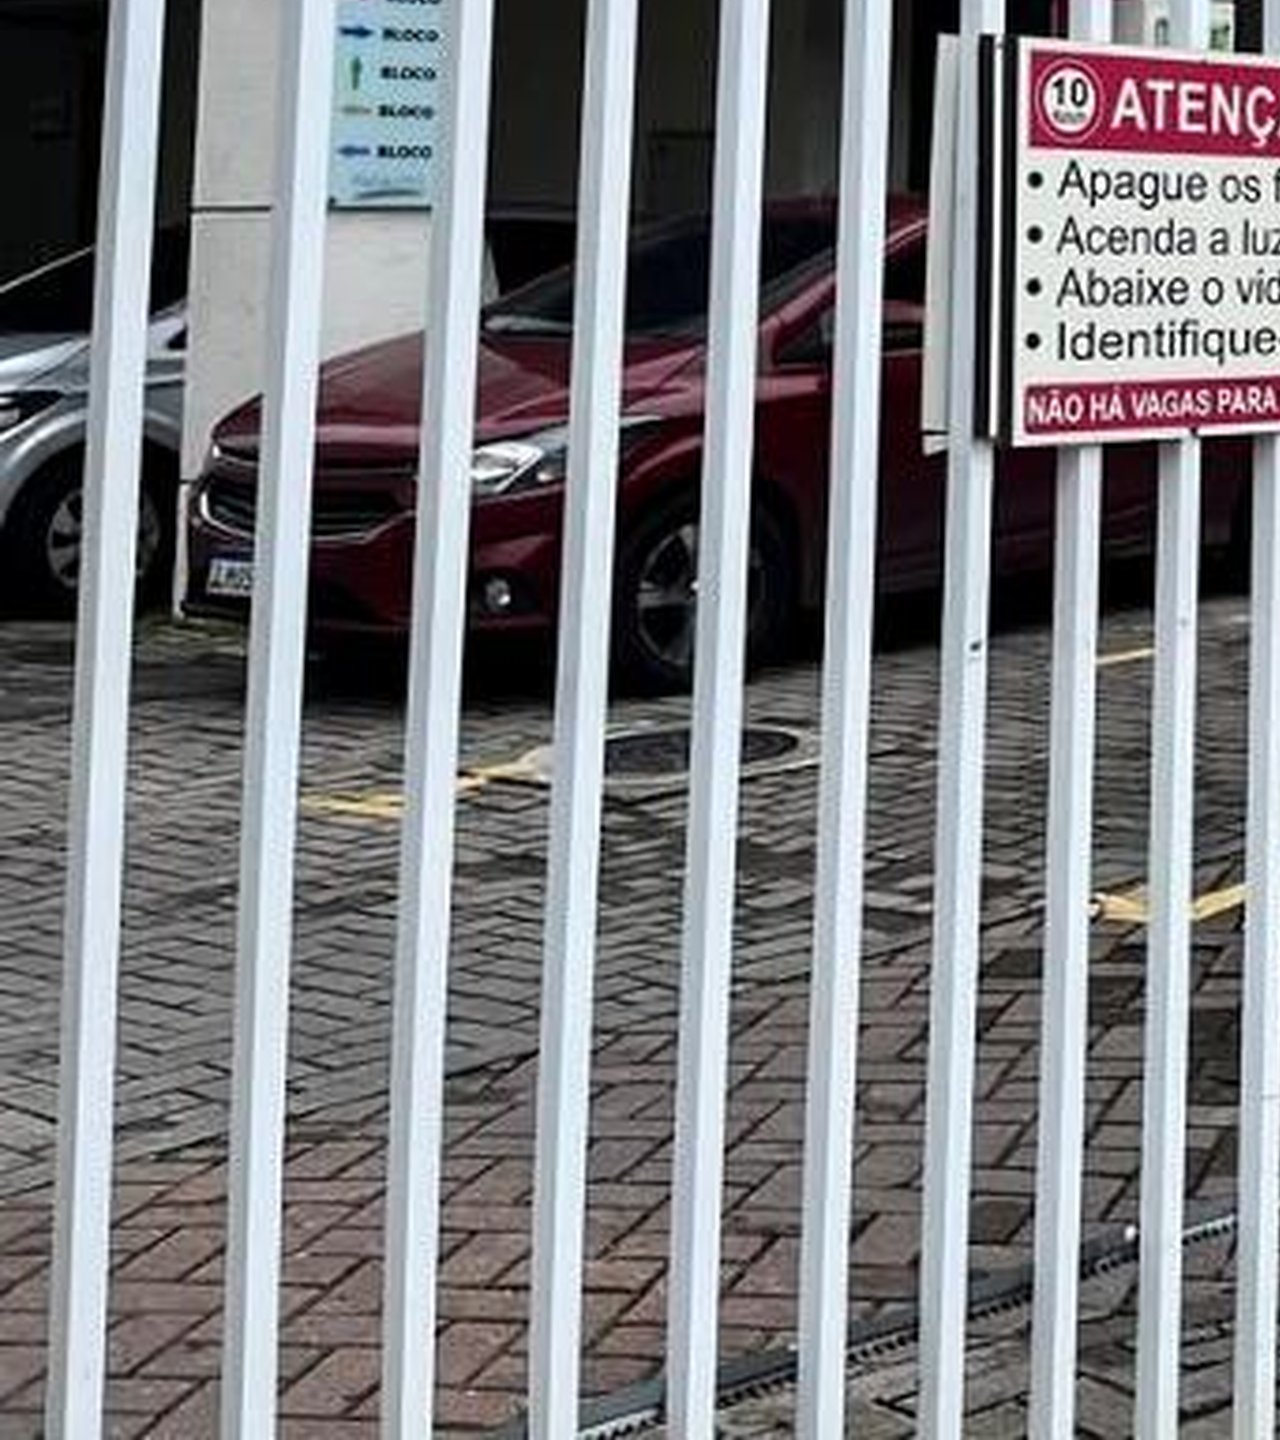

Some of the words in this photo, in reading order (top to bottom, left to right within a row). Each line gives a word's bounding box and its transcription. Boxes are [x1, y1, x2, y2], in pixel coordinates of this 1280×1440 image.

[382, 28, 438, 42] BLOCO
[380, 66, 436, 80] BLOCO
[1052, 77, 1089, 107] 10
[378, 105, 434, 120] BLOCO
[377, 145, 432, 160] BLOCO
[1057, 160, 1208, 210] Apague
[1220, 173, 1262, 204] os
[1056, 216, 1196, 256] Acenda
[1209, 228, 1229, 256] a
[1056, 268, 1189, 307] Abaixe
[1202, 278, 1224, 306] o
[1029, 391, 1084, 424] NÃO
[1091, 390, 1126, 422] HÁ
[1131, 389, 1211, 418] VAGAS
[1217, 386, 1278, 414] PARA
